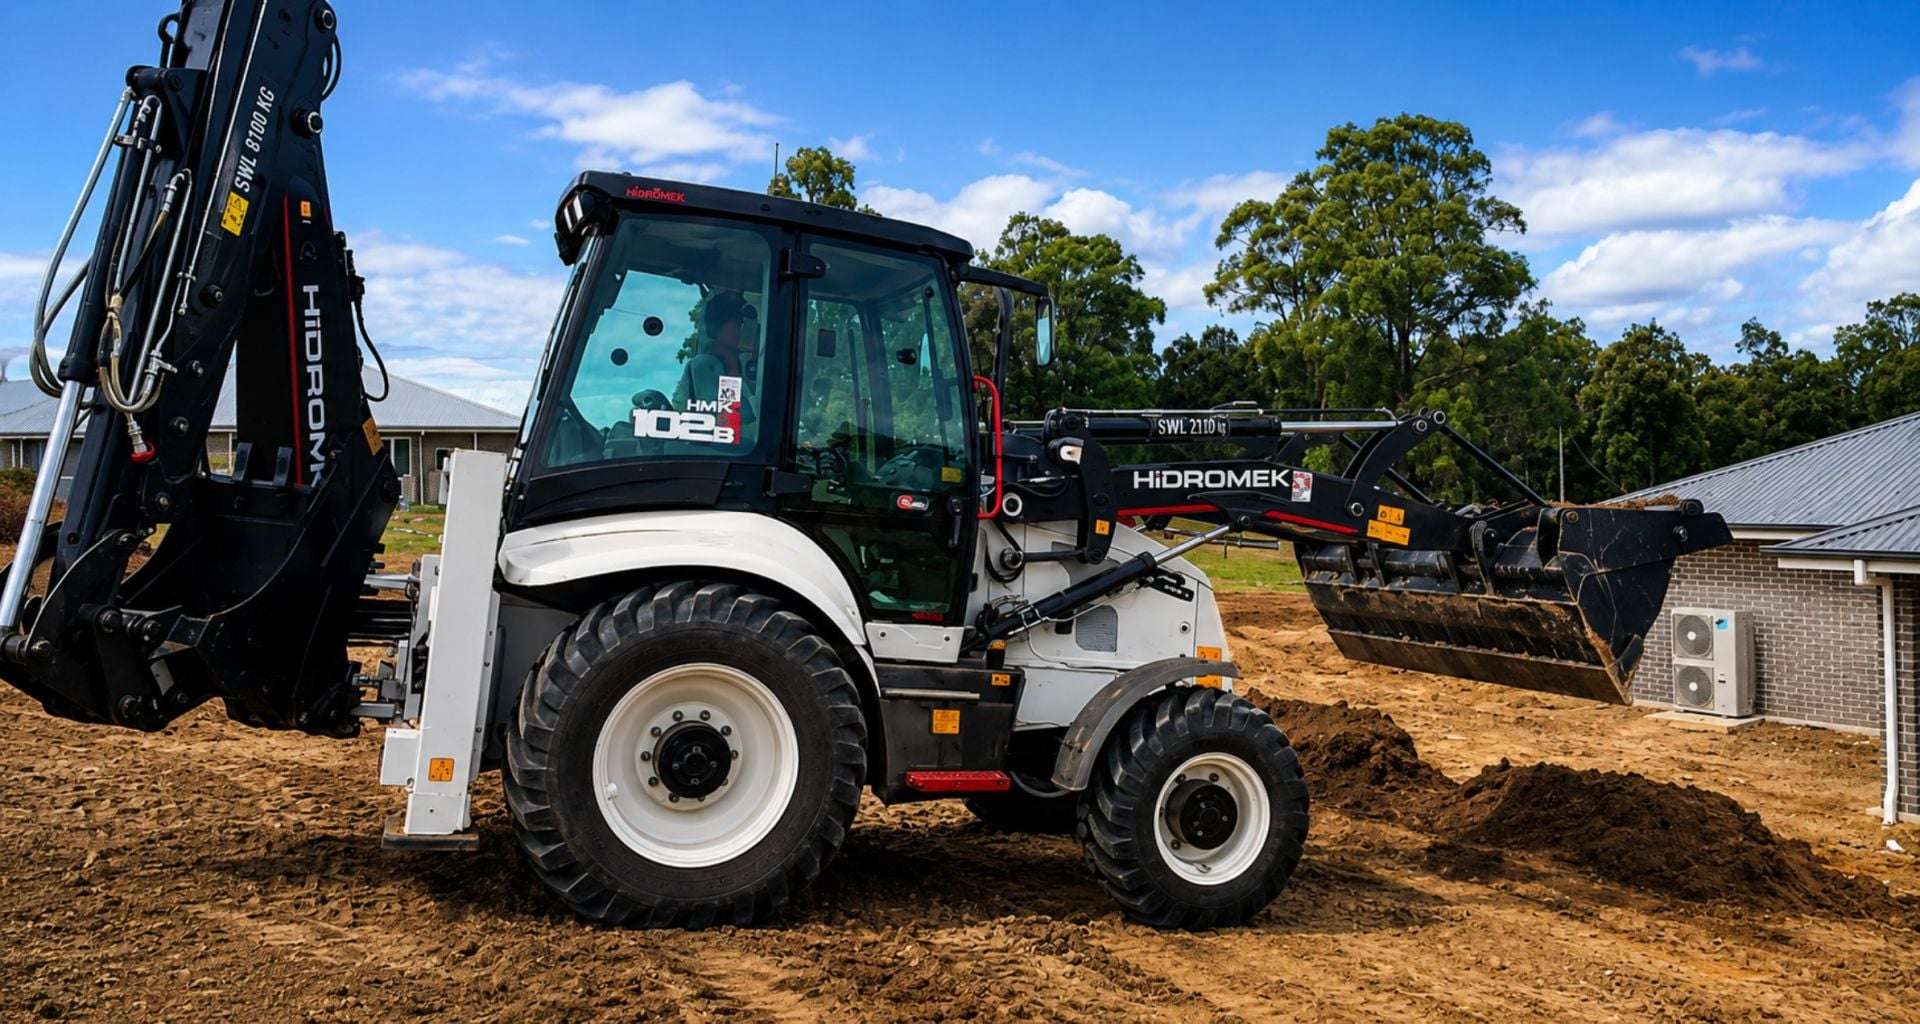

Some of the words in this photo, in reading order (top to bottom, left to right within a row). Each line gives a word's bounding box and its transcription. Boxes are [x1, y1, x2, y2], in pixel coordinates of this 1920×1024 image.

[256, 86, 275, 113] KG
[245, 110, 268, 153] 8100
[234, 155, 257, 193] SWL
[687, 399, 734, 414] HMK
[1158, 418, 1188, 435] SWL
